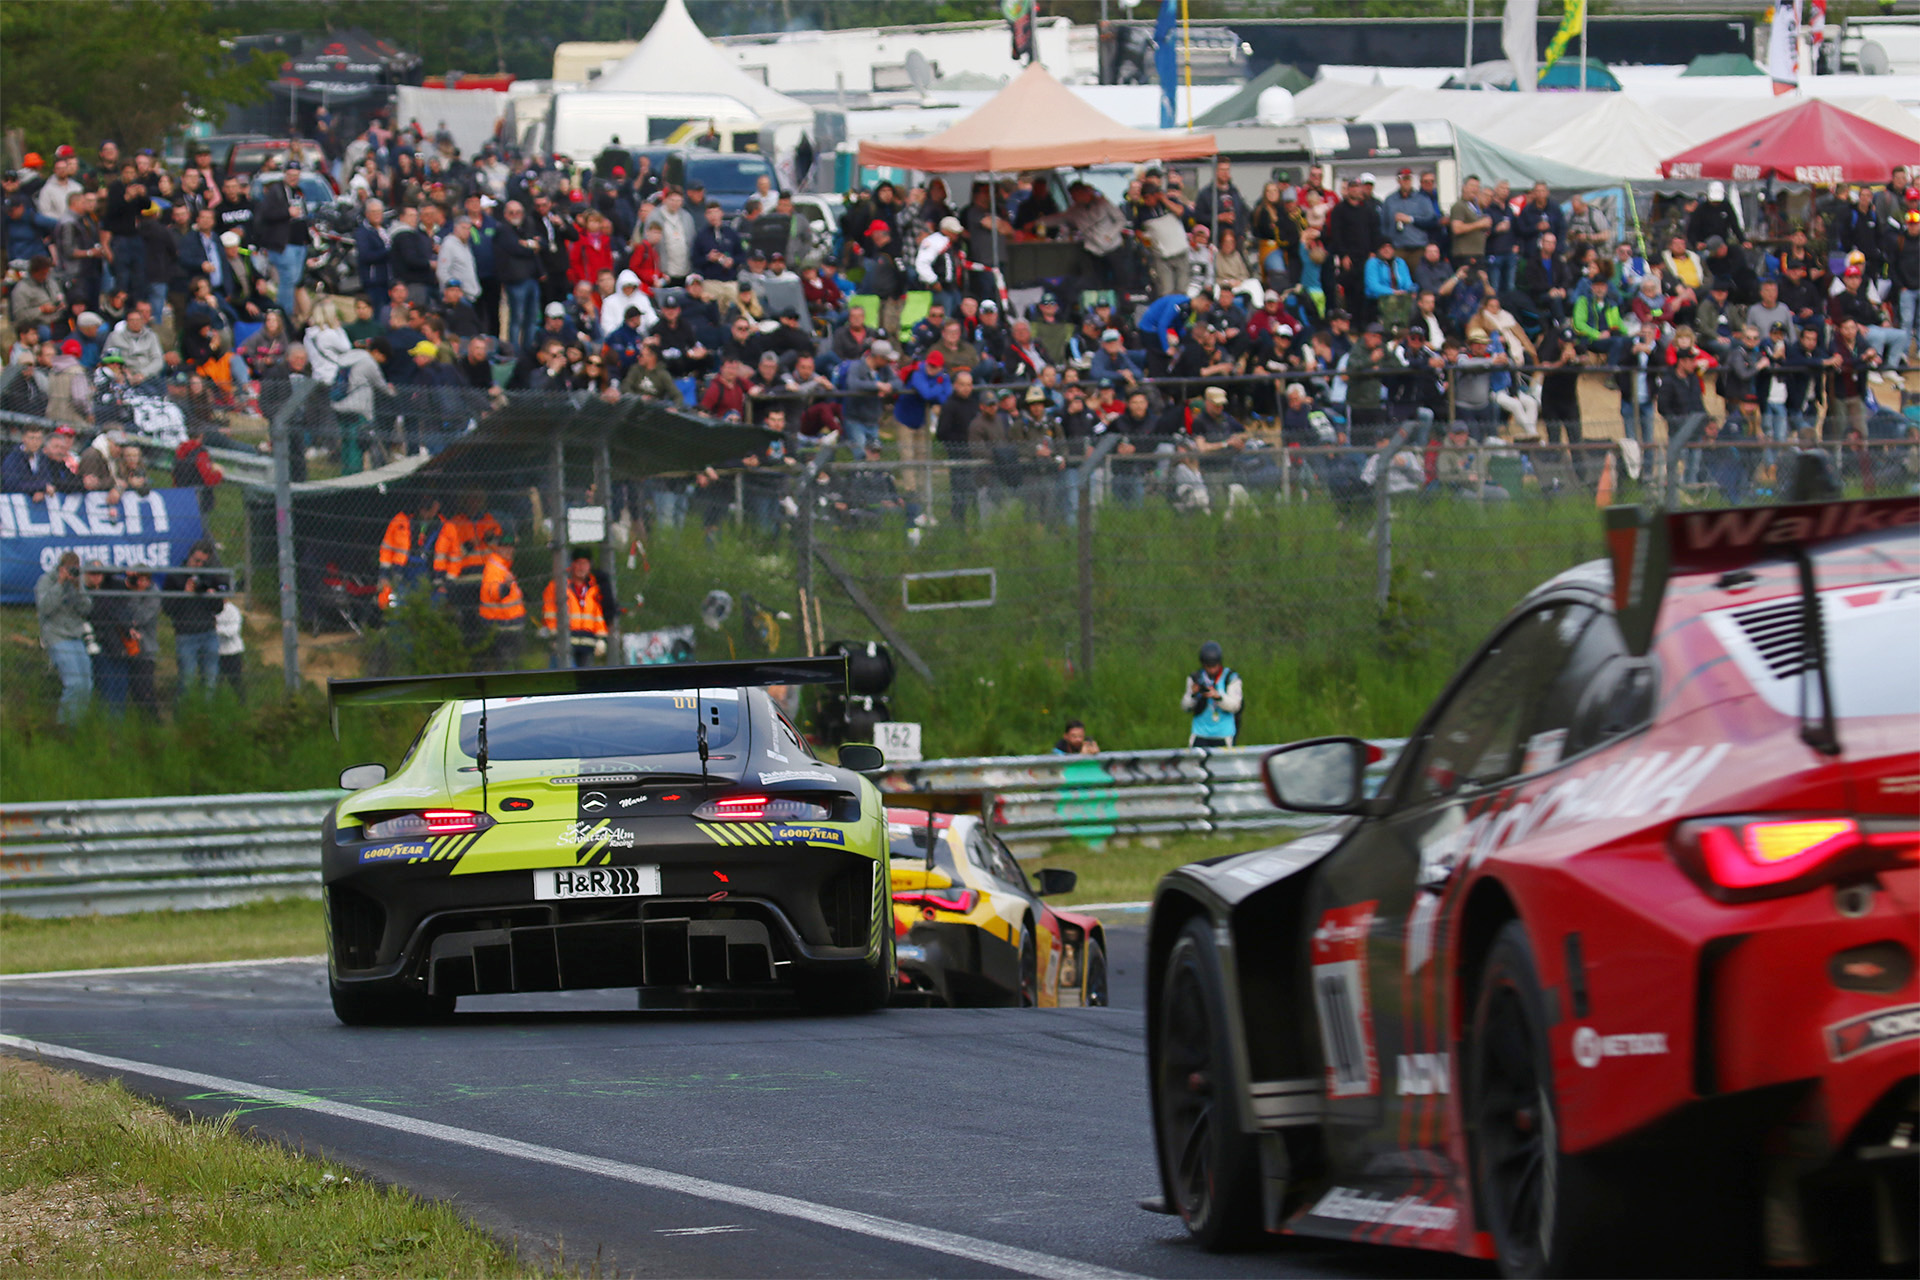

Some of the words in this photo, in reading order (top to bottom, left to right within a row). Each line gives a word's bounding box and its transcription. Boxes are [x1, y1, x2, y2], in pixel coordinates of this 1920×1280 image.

[1795, 165, 1844, 183] REWE
[113, 541, 171, 568] PULSE
[883, 725, 911, 748] 162
[779, 827, 839, 841] GOODYEAR
[364, 844, 424, 859] GOODYEAR
[554, 869, 609, 896] H&R
